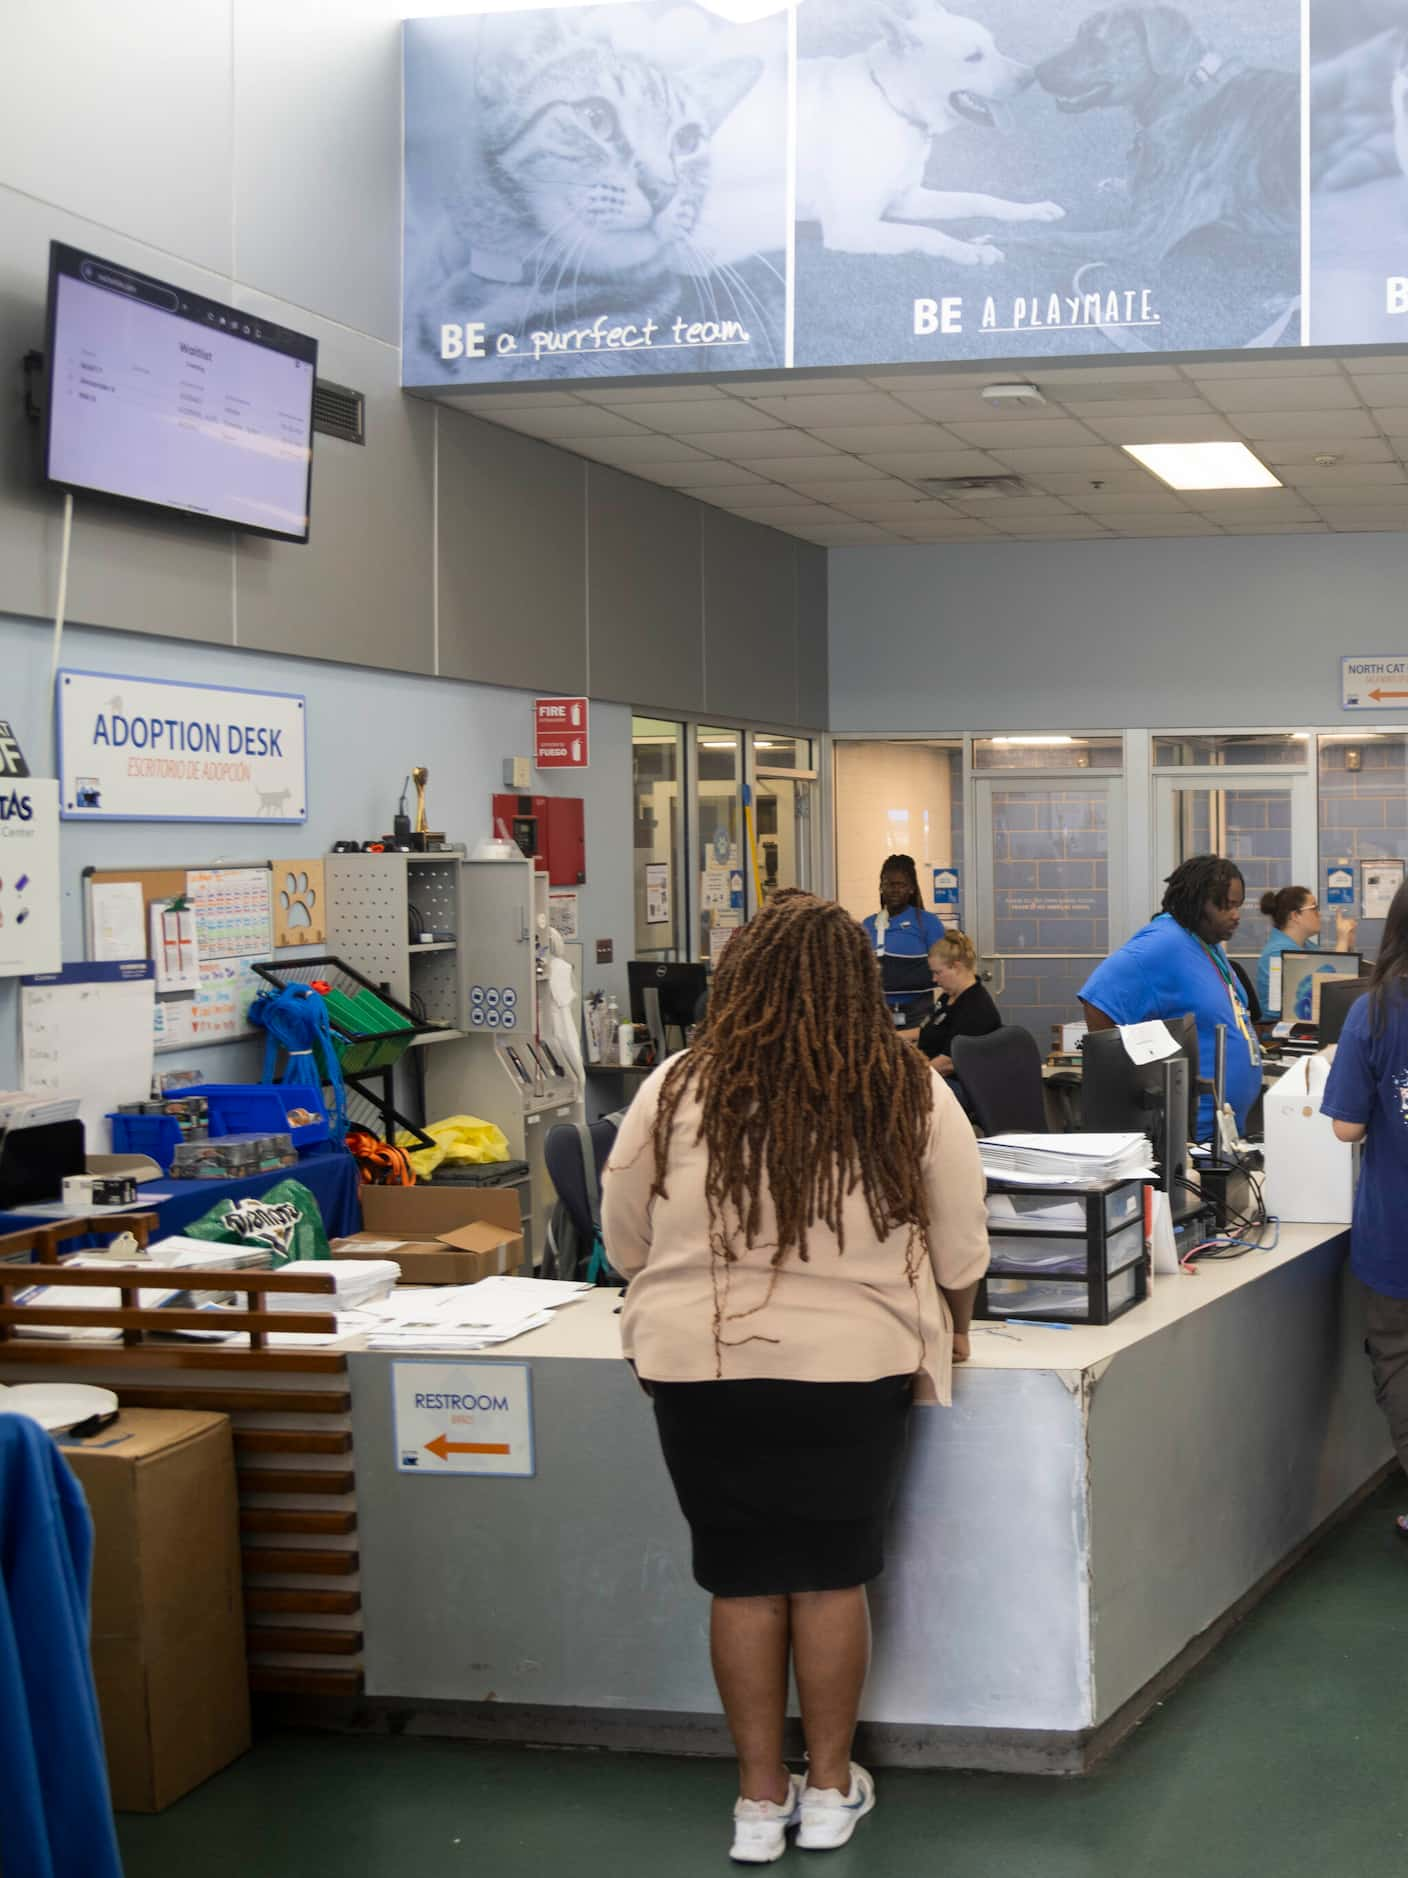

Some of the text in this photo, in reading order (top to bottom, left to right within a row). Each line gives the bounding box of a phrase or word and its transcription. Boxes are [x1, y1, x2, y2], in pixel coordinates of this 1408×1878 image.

[914, 290, 1160, 334] BE A PLAYMATE.
[441, 316, 751, 359] BE a purrfect team.
[1348, 664, 1384, 674] NORTH
[1386, 663, 1405, 673] CAT
[539, 706, 567, 717] FIRE
[93, 714, 283, 757] ADOPTION DESK
[415, 1393, 509, 1411] RESTROOM
